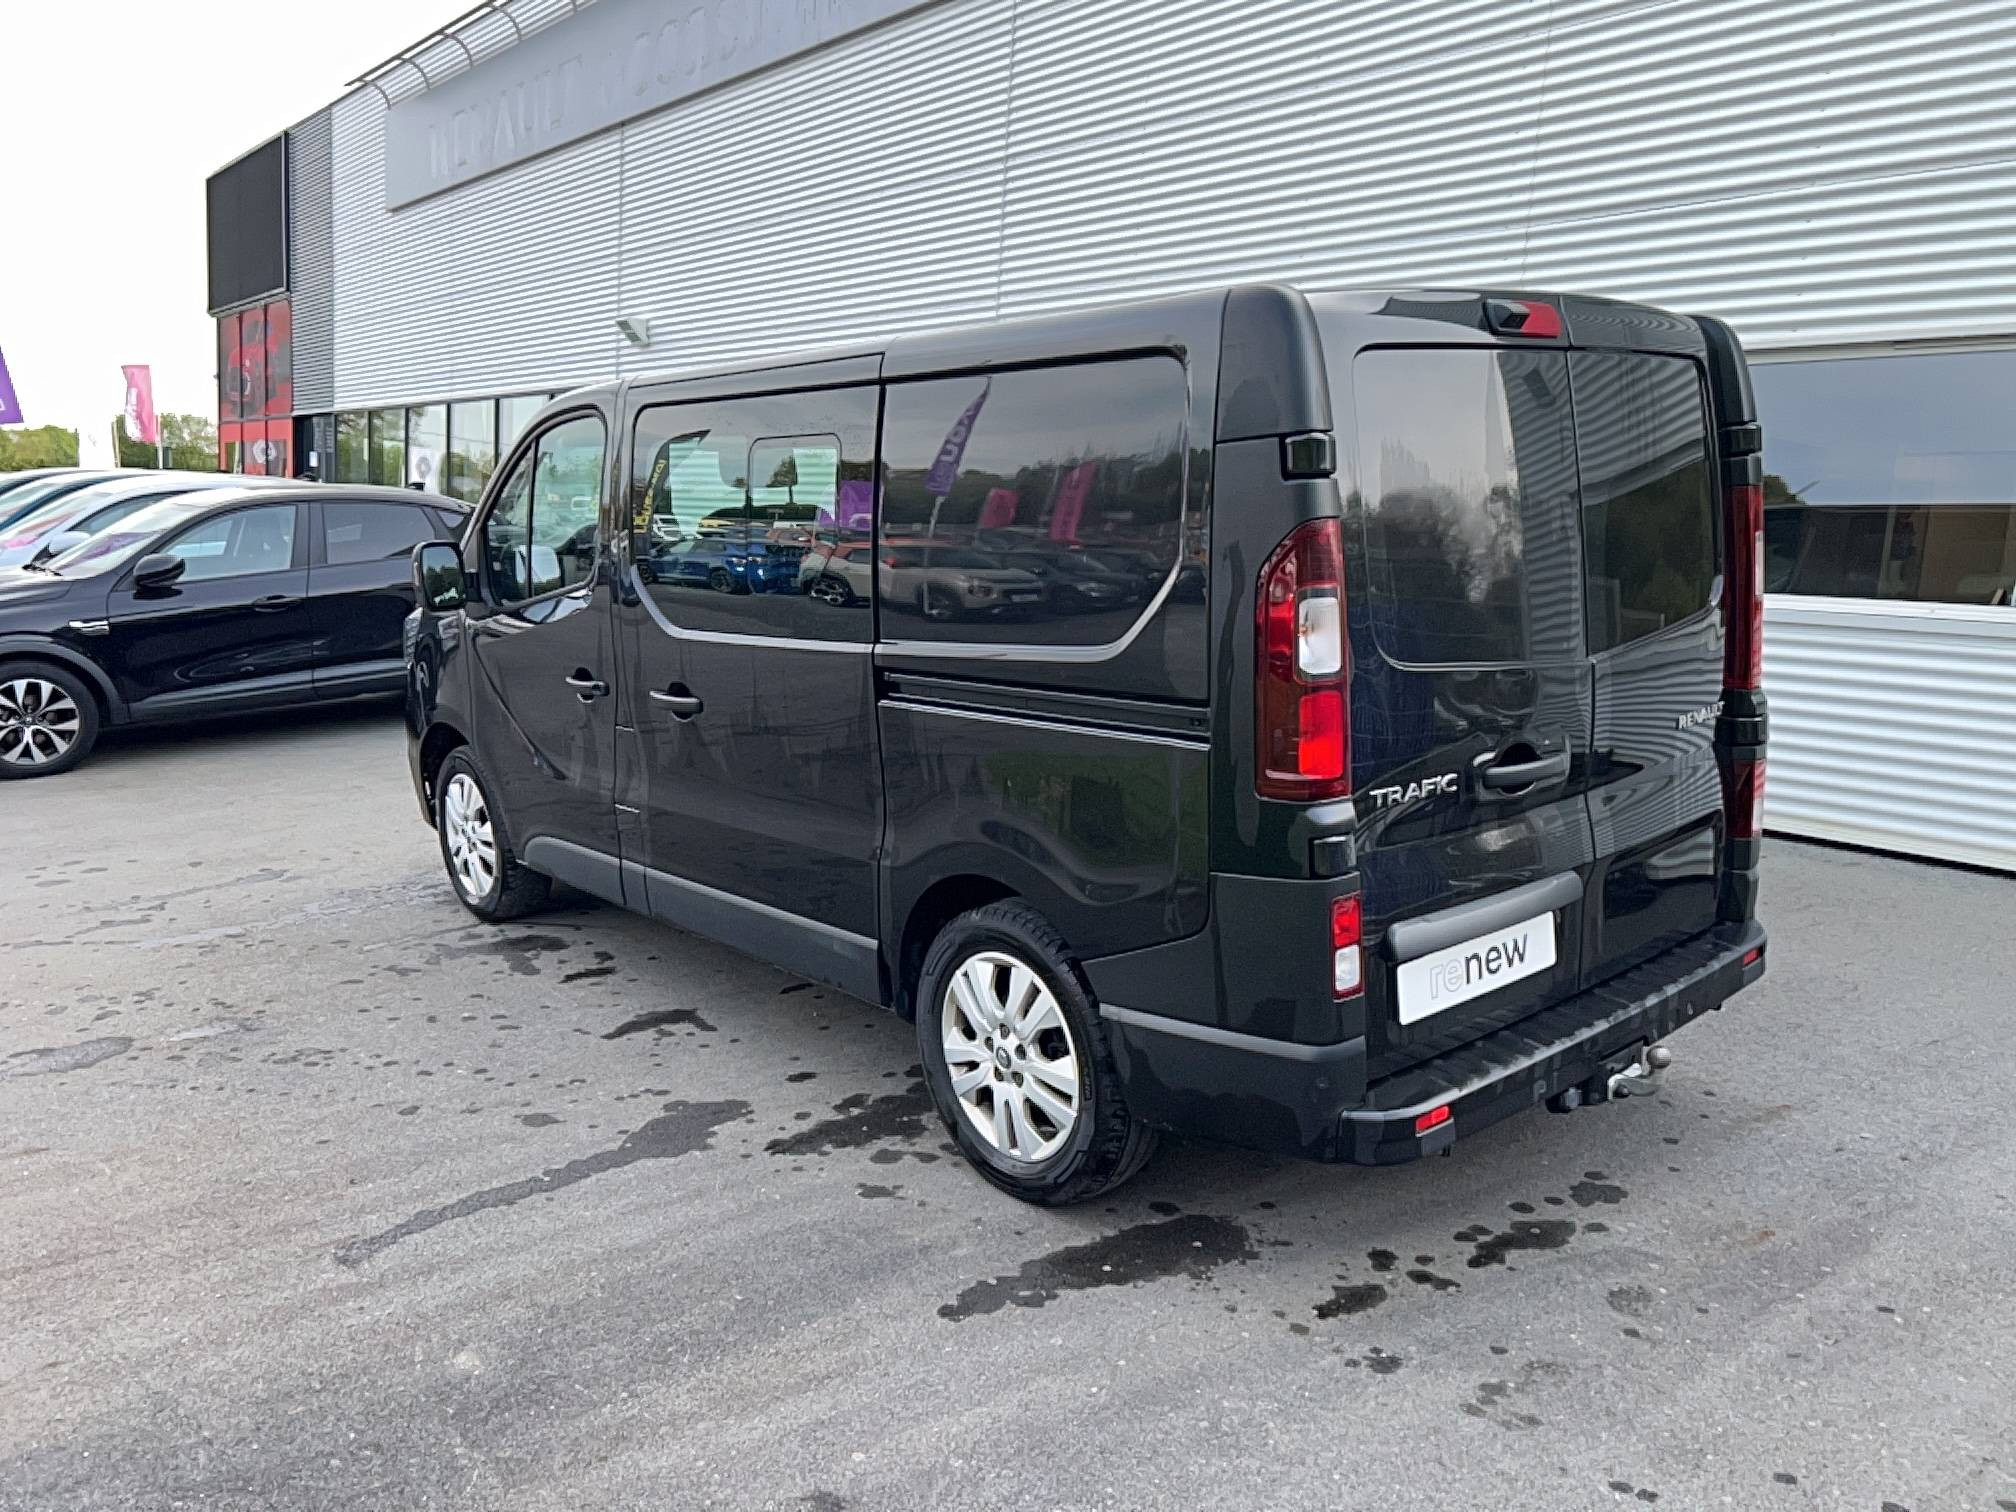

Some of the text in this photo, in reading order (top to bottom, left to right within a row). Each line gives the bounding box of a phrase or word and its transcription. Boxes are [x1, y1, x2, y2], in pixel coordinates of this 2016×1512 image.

[1679, 700, 1725, 729] RENAULT
[1369, 773, 1458, 809] TRAFIC
[1430, 931, 1528, 1000] renew
